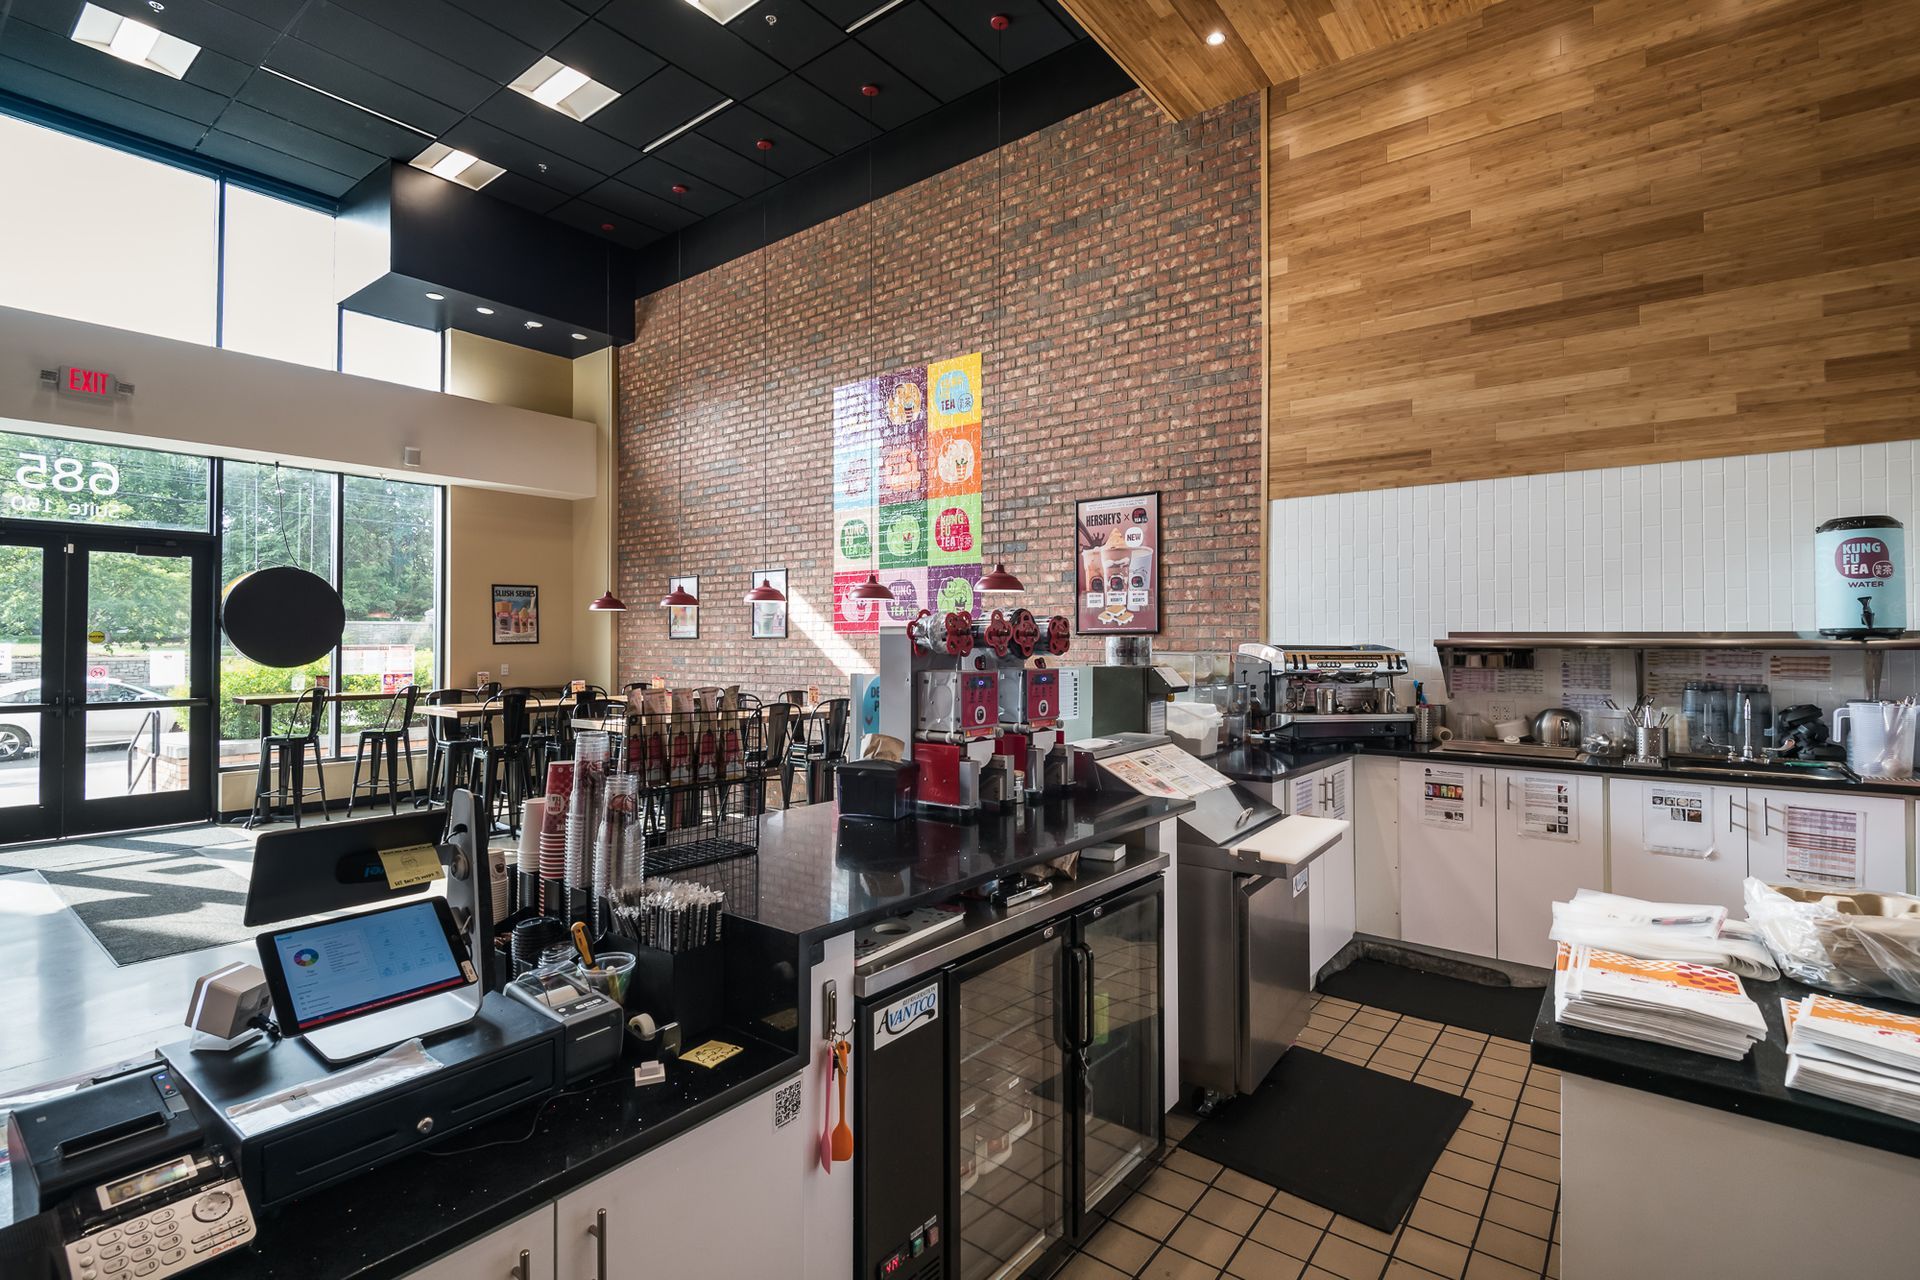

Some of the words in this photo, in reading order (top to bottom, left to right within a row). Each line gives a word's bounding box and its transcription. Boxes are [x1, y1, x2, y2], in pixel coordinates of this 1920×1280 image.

[70, 367, 109, 395] EXIT
[941, 536, 956, 547] TEA
[1127, 533, 1142, 541] NEW
[1842, 543, 1880, 553] KUNG
[1843, 554, 1859, 564] FU
[1843, 564, 1868, 574] TEA
[495, 589, 515, 597] SLUSH
[516, 590, 536, 598] SERIES
[876, 994, 936, 1035] AVANTCO
